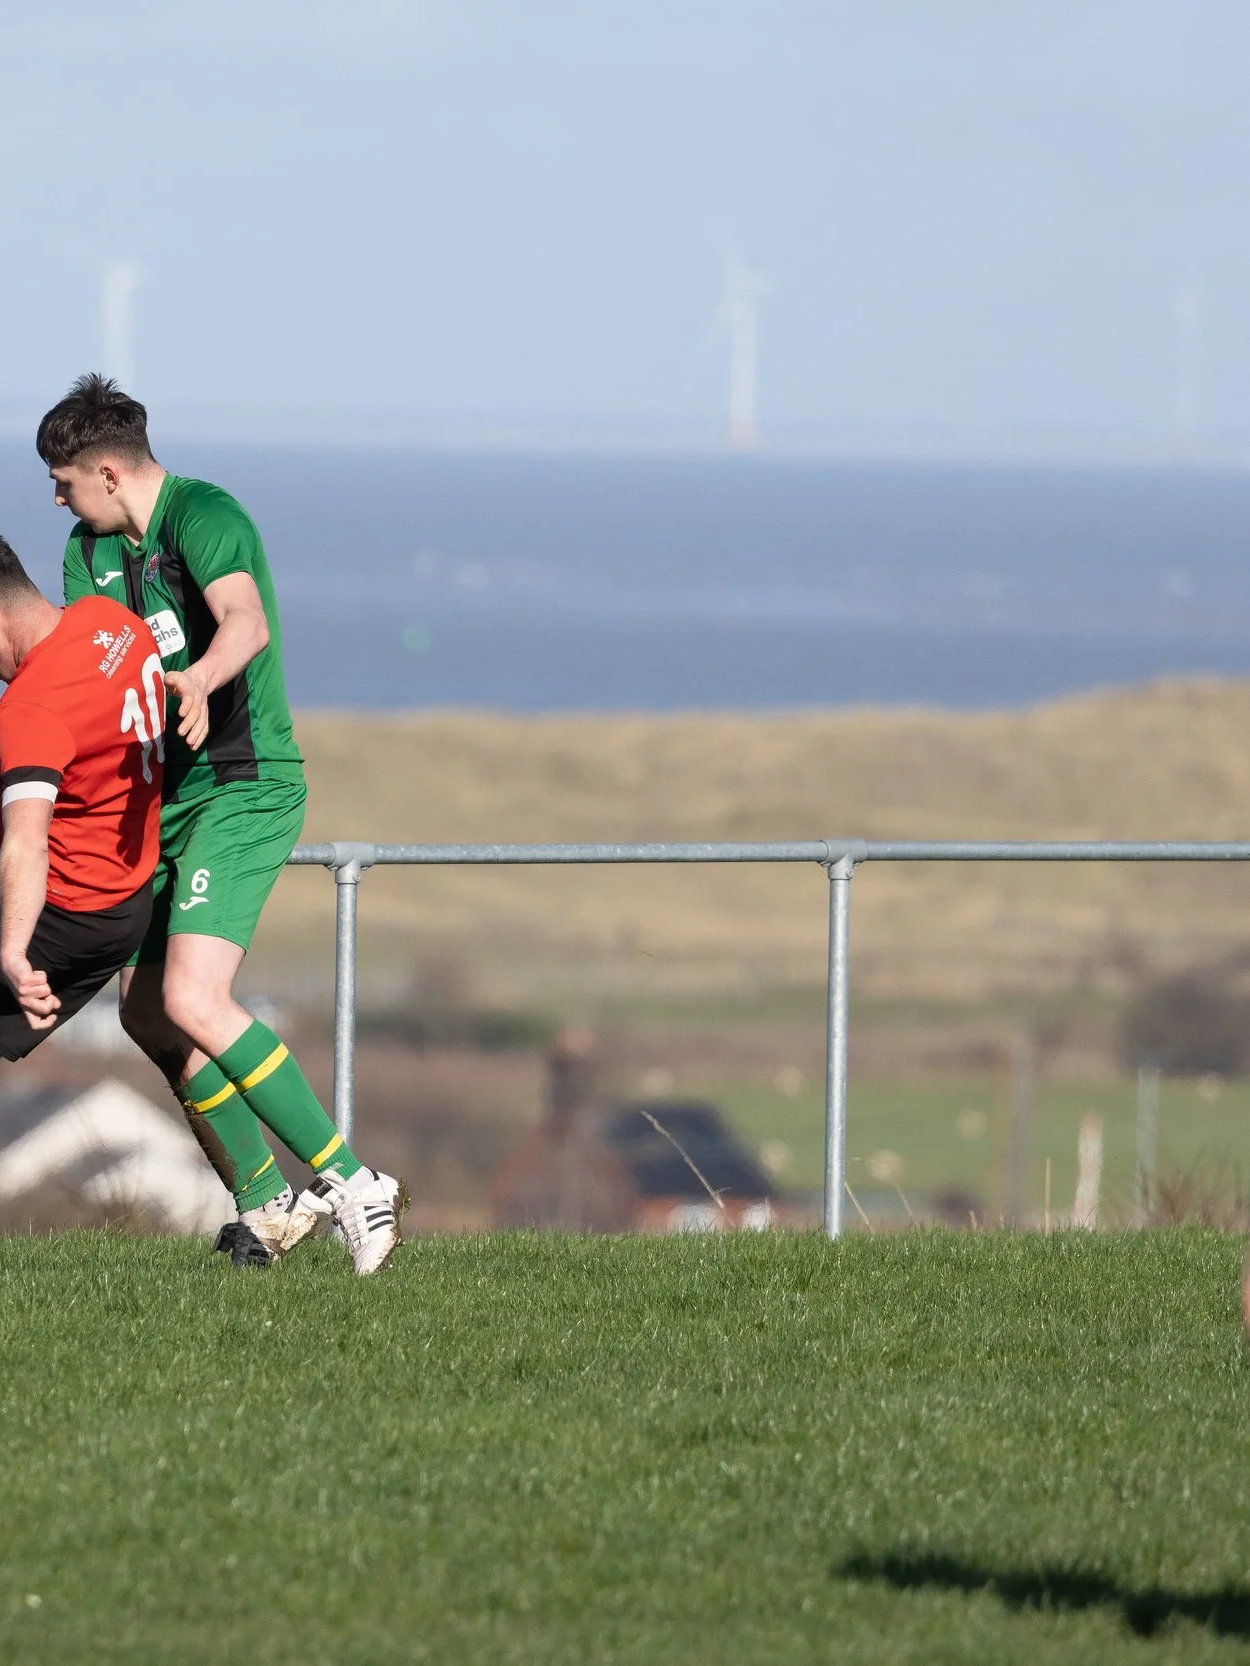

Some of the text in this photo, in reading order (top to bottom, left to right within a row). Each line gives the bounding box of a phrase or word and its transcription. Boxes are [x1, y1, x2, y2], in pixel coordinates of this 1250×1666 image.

[98, 624, 131, 673] RG HOWELLS
[120, 653, 166, 784] 10
[191, 868, 211, 894] 6
